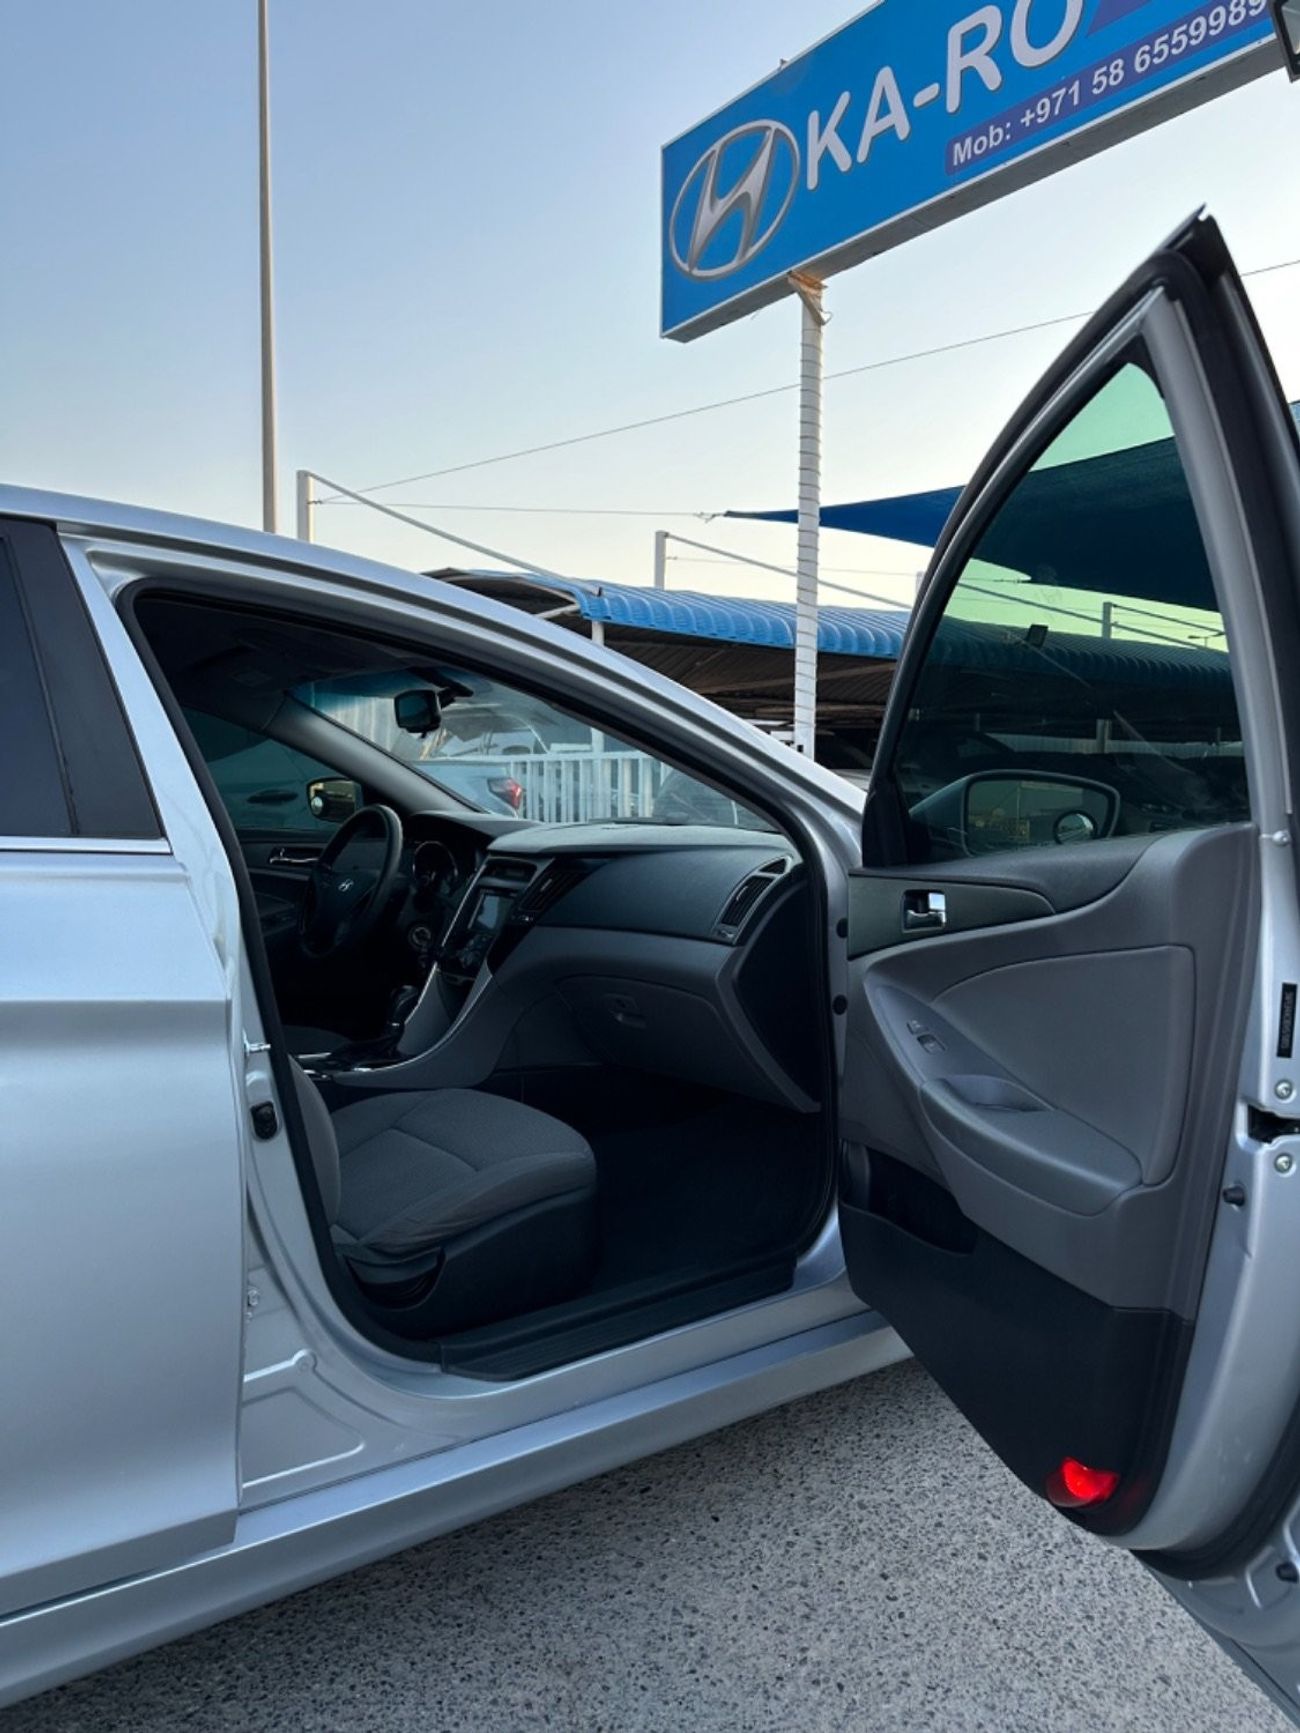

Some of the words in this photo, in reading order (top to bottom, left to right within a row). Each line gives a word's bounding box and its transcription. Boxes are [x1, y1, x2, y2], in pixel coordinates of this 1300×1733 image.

[952, 122, 1011, 166] Mob:
[1020, 80, 1081, 128] +971
[1091, 58, 1125, 95] 58
